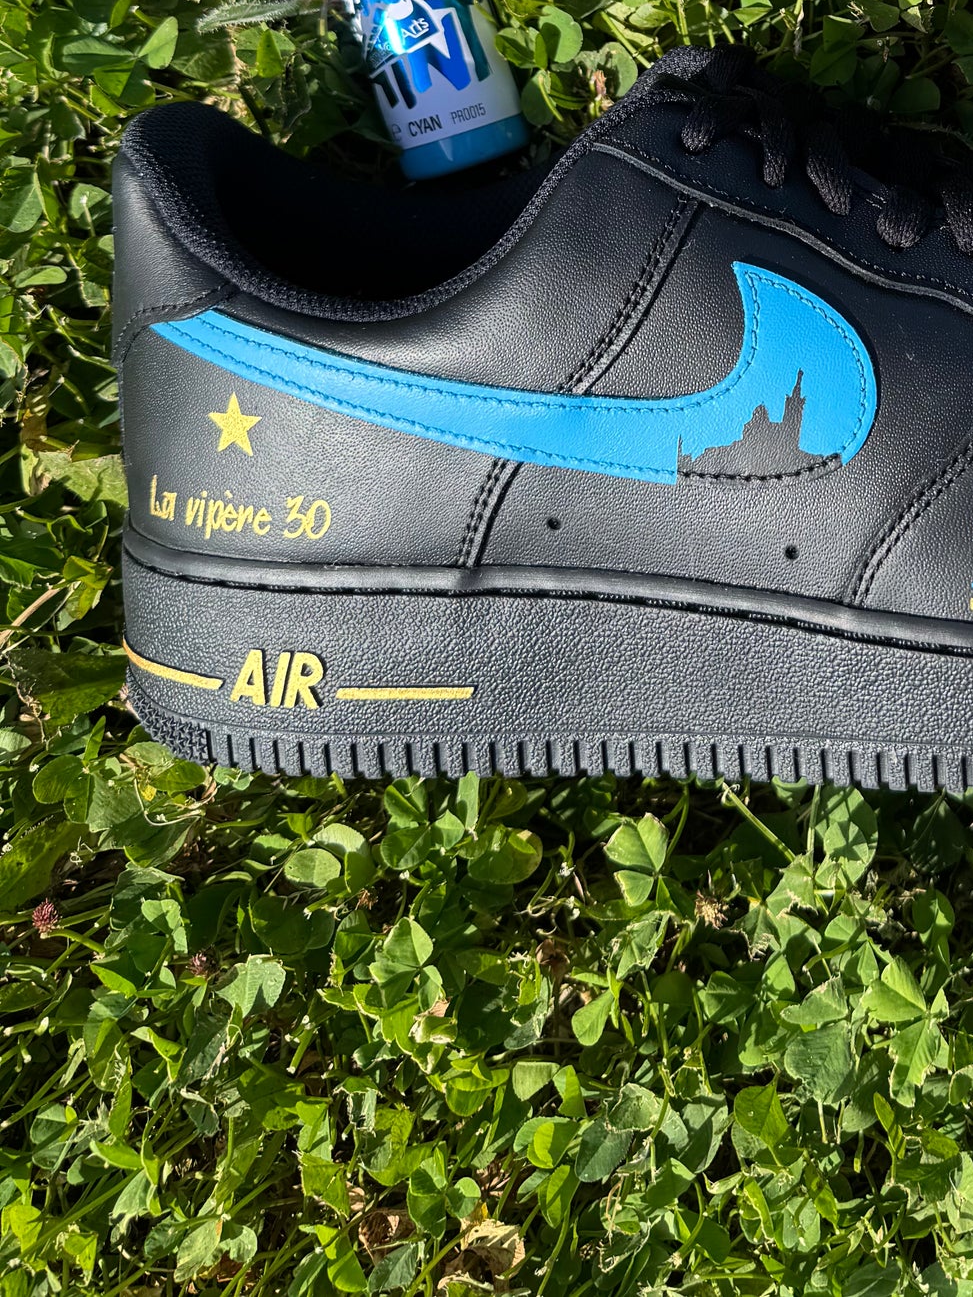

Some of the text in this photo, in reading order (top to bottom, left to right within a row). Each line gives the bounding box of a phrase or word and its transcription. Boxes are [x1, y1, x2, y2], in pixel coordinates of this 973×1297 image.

[408, 114, 443, 137] CYAN
[149, 475, 332, 540] La vipère 30
[229, 648, 326, 710] AIR
